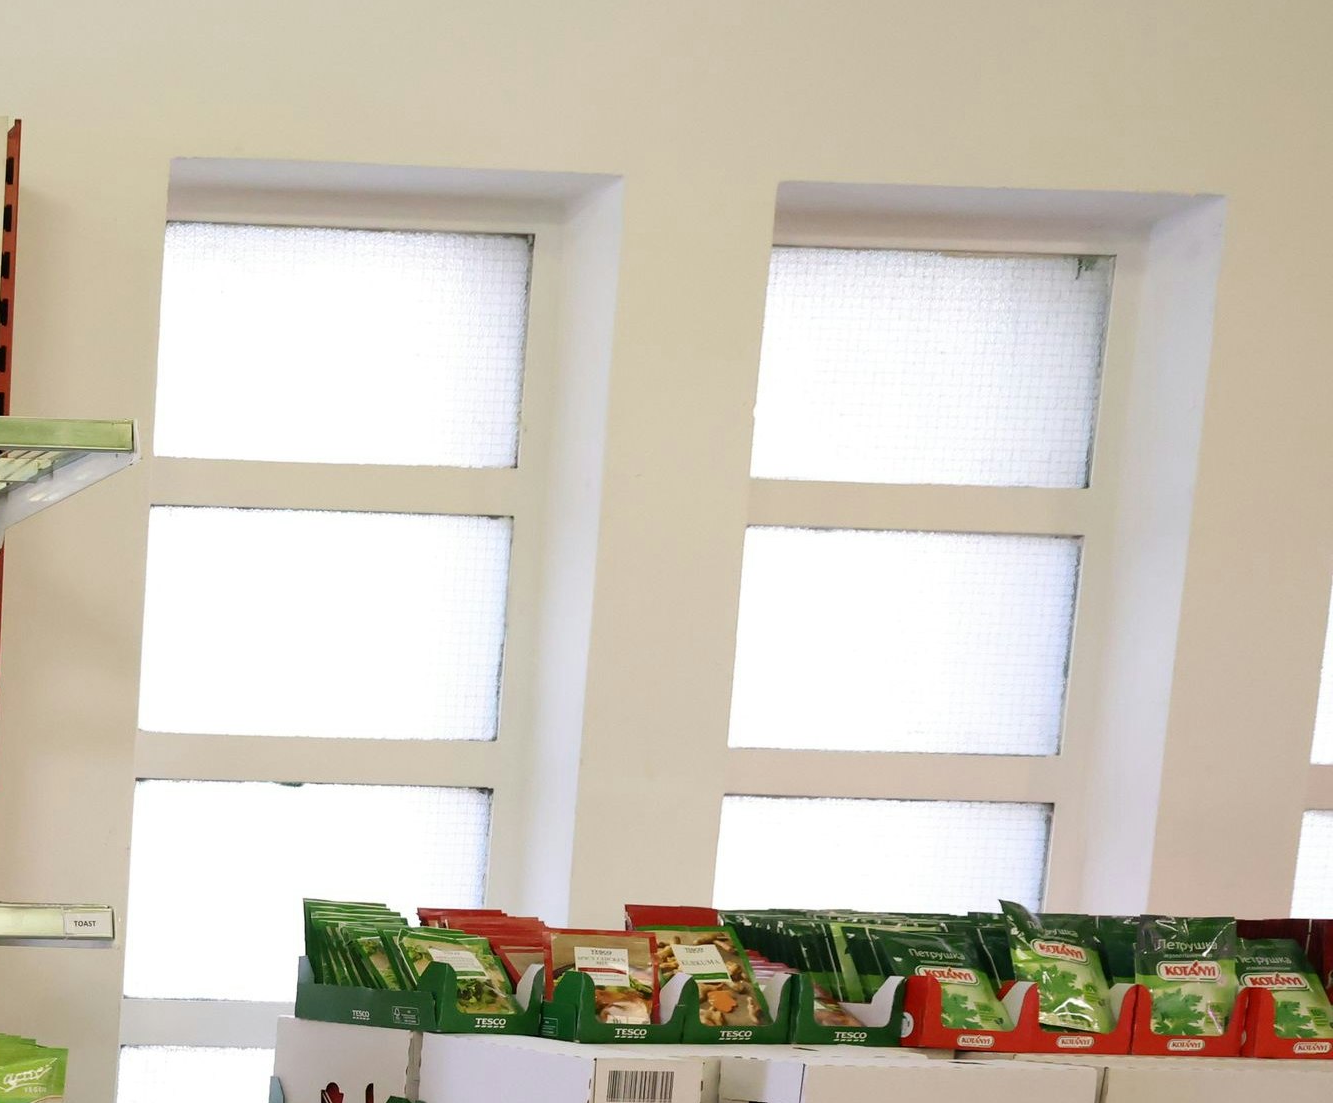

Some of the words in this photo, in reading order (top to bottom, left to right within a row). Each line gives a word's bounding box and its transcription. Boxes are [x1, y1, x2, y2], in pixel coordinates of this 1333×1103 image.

[74, 920, 96, 928] TOAST
[908, 948, 965, 961] Петрушка
[1039, 942, 1084, 960] KOTÁNYI
[1164, 960, 1218, 979] KOTÁNYI
[1248, 973, 1305, 988] KOTÁNYI
[475, 1018, 506, 1027] TESCO
[615, 1028, 647, 1037] TESCO
[835, 1031, 867, 1041] TESCO
